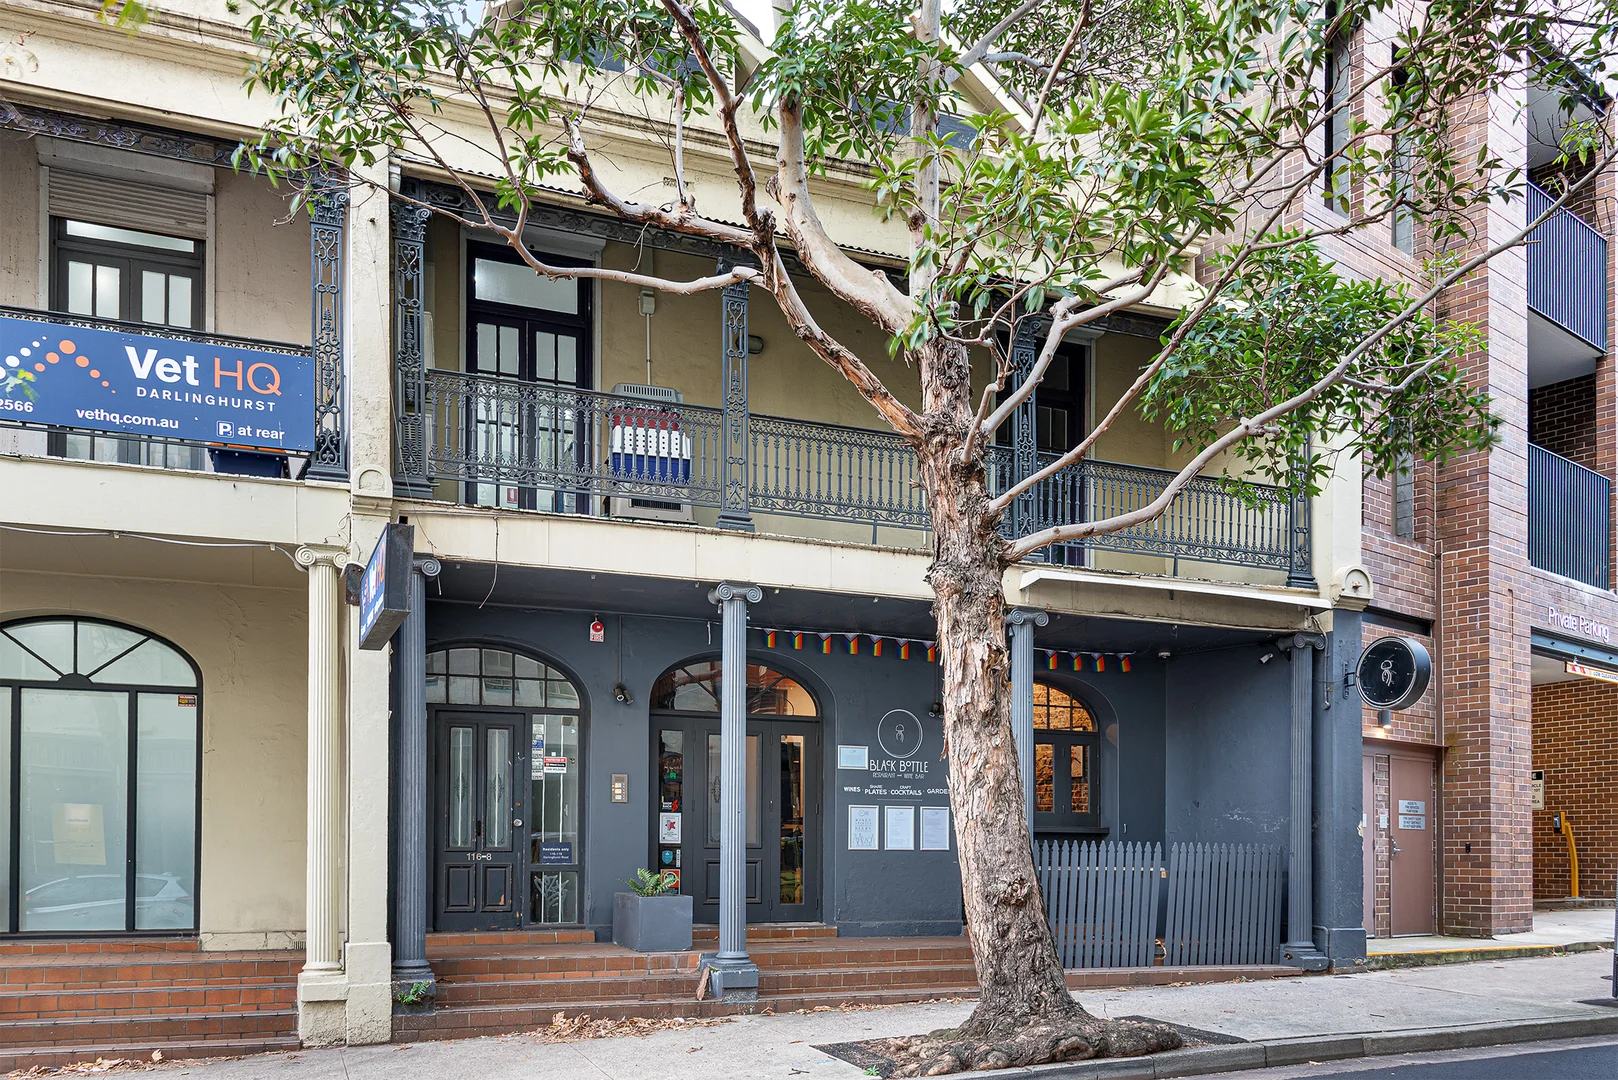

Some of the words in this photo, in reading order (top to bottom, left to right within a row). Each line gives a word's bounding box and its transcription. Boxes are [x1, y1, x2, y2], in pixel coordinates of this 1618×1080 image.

[124, 345, 200, 387] Vet
[213, 356, 283, 397] HQ
[136, 386, 276, 412] DARLINGHURST
[76, 409, 179, 429] vethq.com.au
[237, 425, 253, 437] at
[256, 428, 285, 440] rear
[1548, 606, 1577, 631] Private
[1579, 615, 1610, 643] Parking
[869, 759, 896, 772] BLACK
[899, 760, 929, 773] BOTTLE
[466, 852, 493, 861] 116-8
